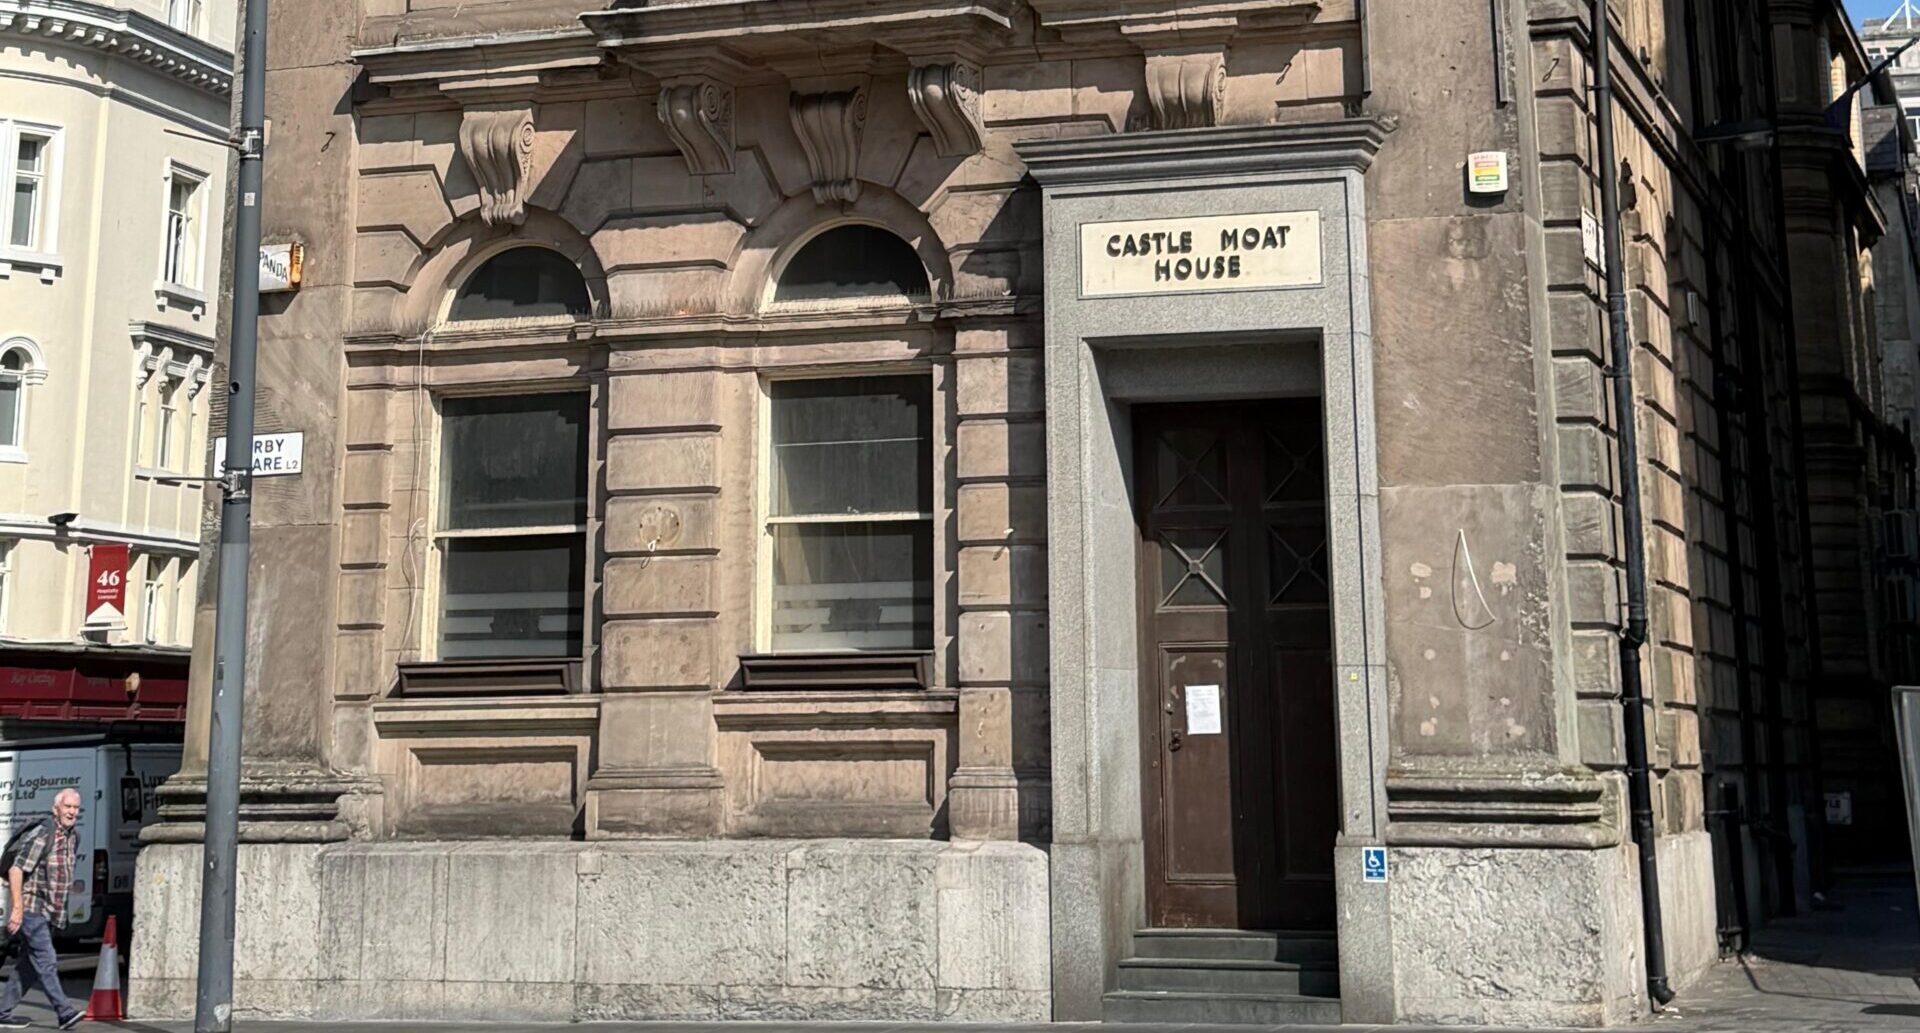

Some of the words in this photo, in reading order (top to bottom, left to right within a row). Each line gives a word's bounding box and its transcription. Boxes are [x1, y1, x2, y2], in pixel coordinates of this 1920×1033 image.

[1106, 231, 1193, 257] CASTLE
[1220, 225, 1291, 252] MOAT
[1154, 255, 1241, 282] HOUSE
[254, 438, 284, 453] RBY
[286, 460, 299, 470] L2
[96, 570, 121, 586] 46
[18, 775, 81, 791] Logburner
[15, 789, 36, 800] Ltd
